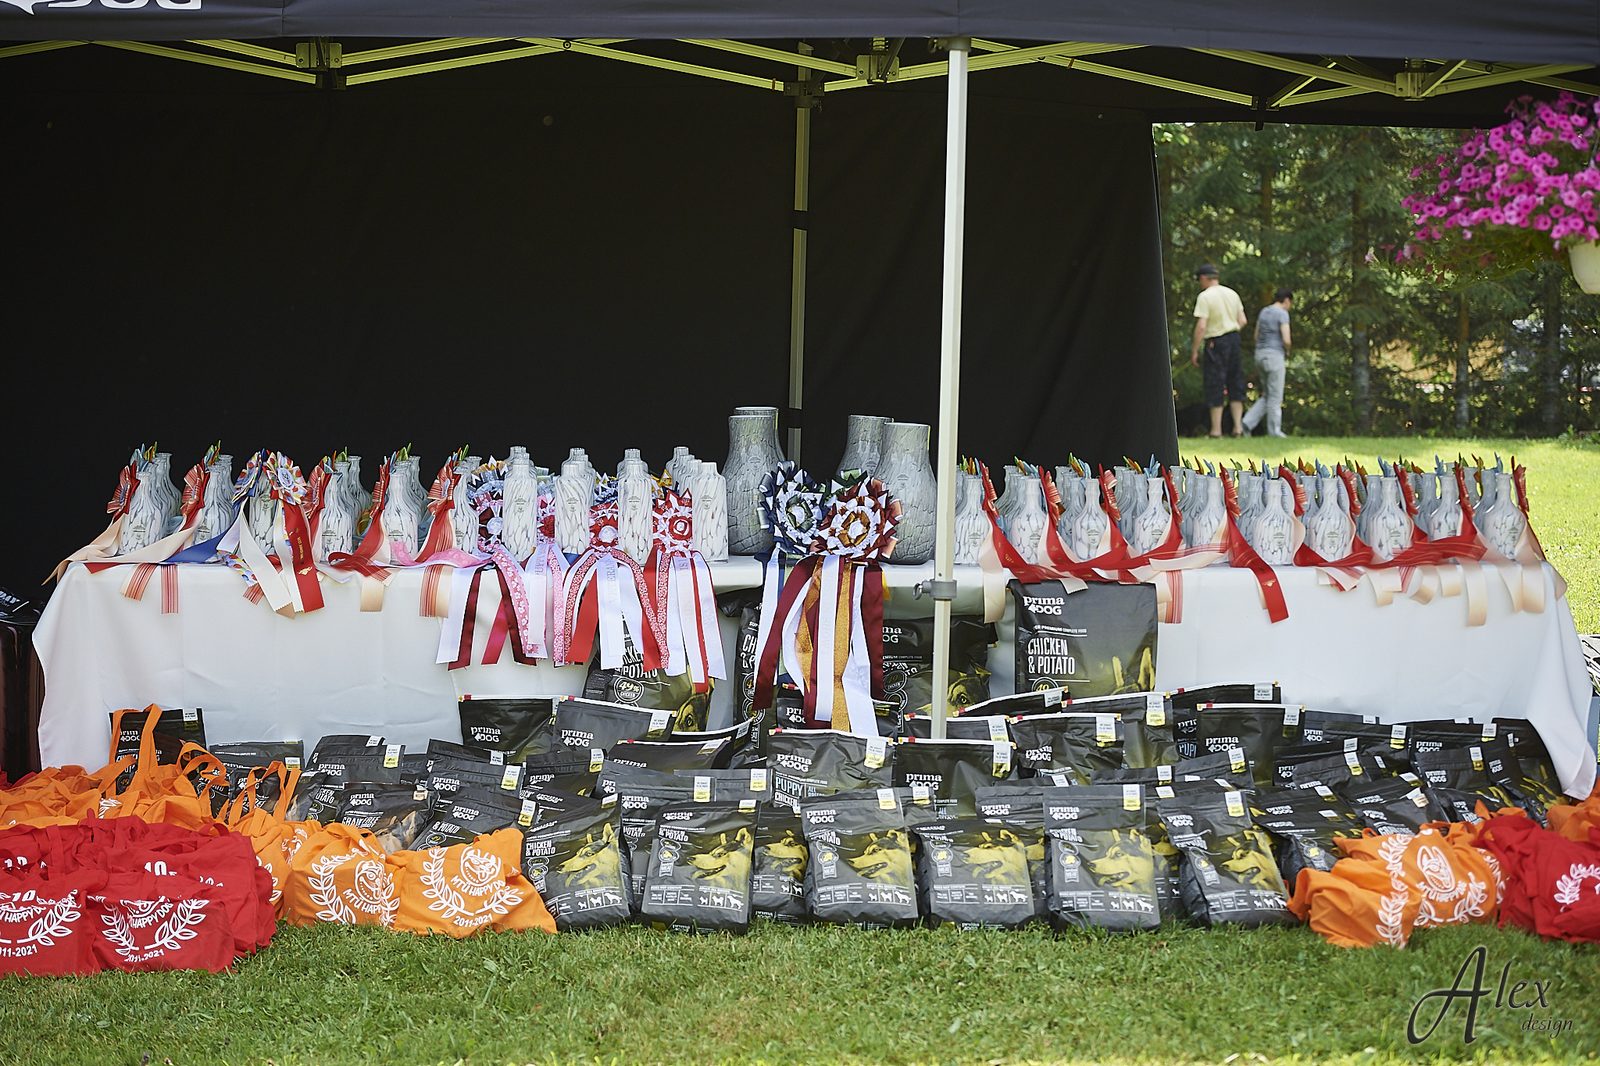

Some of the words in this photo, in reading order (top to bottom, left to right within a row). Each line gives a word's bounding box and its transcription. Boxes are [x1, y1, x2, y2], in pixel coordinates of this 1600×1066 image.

[1023, 596, 1064, 606] prima
[1028, 638, 1068, 655] CHICKEN
[1028, 656, 1035, 673] &
[1038, 657, 1075, 674] POTATO
[619, 682, 640, 692] 49%
[471, 726, 501, 735] prima
[561, 730, 594, 740] prima
[1206, 736, 1239, 746] prima
[777, 754, 812, 765] prima
[432, 777, 460, 786] prima
[906, 774, 942, 782] prima
[776, 777, 803, 796] PUPPY
[350, 794, 374, 802] prima
[452, 806, 480, 816] prima
[981, 804, 1011, 812] prima
[1049, 807, 1080, 815] prima
[806, 810, 836, 818] prima
[526, 840, 551, 850] CHICKEN
[532, 848, 556, 856] POTATO
[469, 884, 494, 896] HAPPY
[12, 890, 36, 902] 10
[4, 908, 35, 923] HAPPY
[454, 912, 493, 928] 2011-2021
[130, 914, 158, 928] HAPPY
